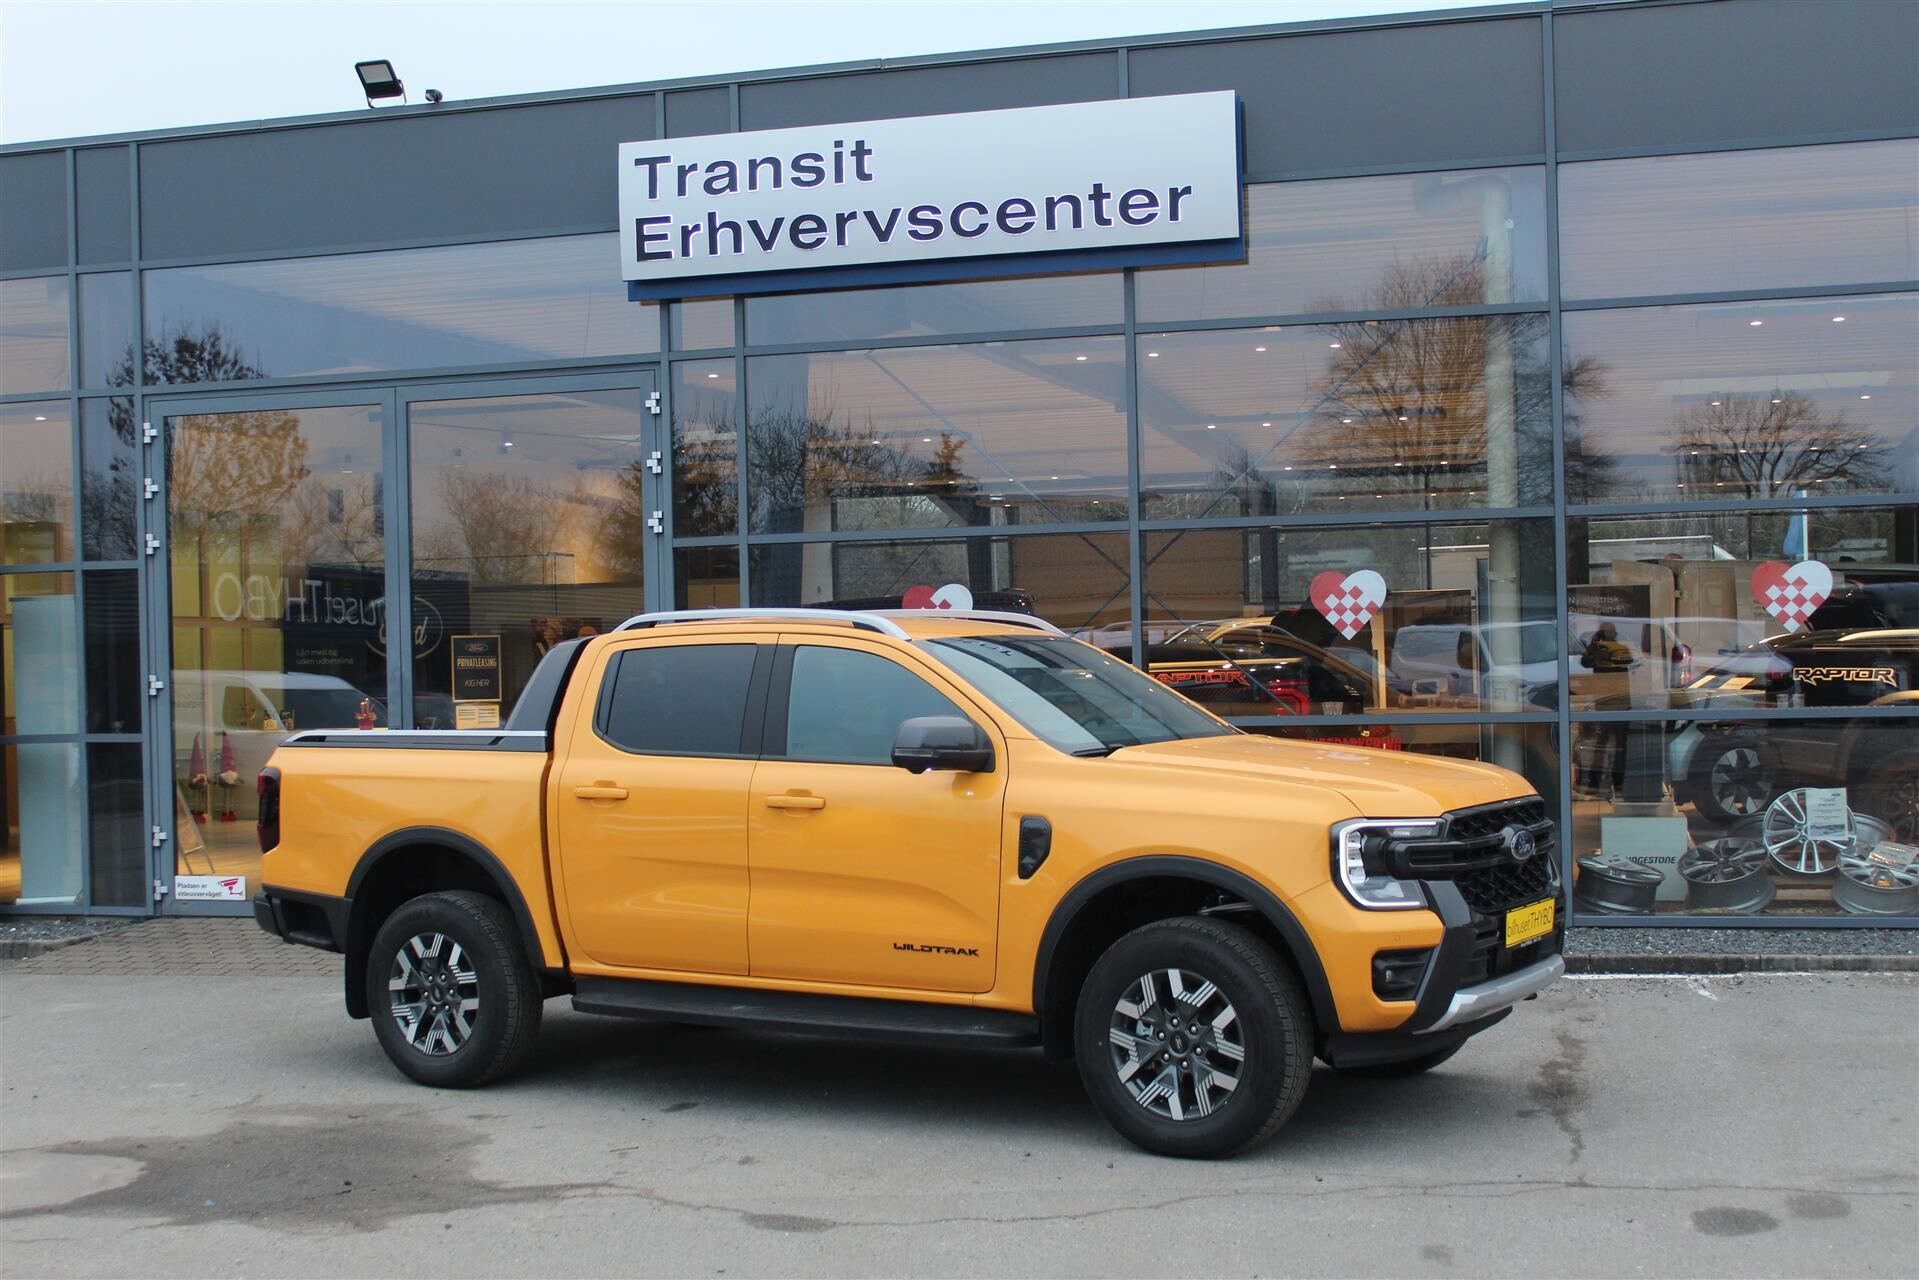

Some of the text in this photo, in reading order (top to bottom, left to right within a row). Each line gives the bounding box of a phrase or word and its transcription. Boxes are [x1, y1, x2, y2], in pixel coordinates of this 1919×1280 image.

[633, 139, 874, 200] Transit
[635, 182, 1193, 263] Erhvervscenter
[457, 658, 497, 667] PRIVATLEASING
[476, 678, 490, 687] HER
[1793, 667, 1898, 688] RAPTOR
[1626, 856, 1677, 864] DGESTONE
[893, 942, 979, 957] WILDTRAK
